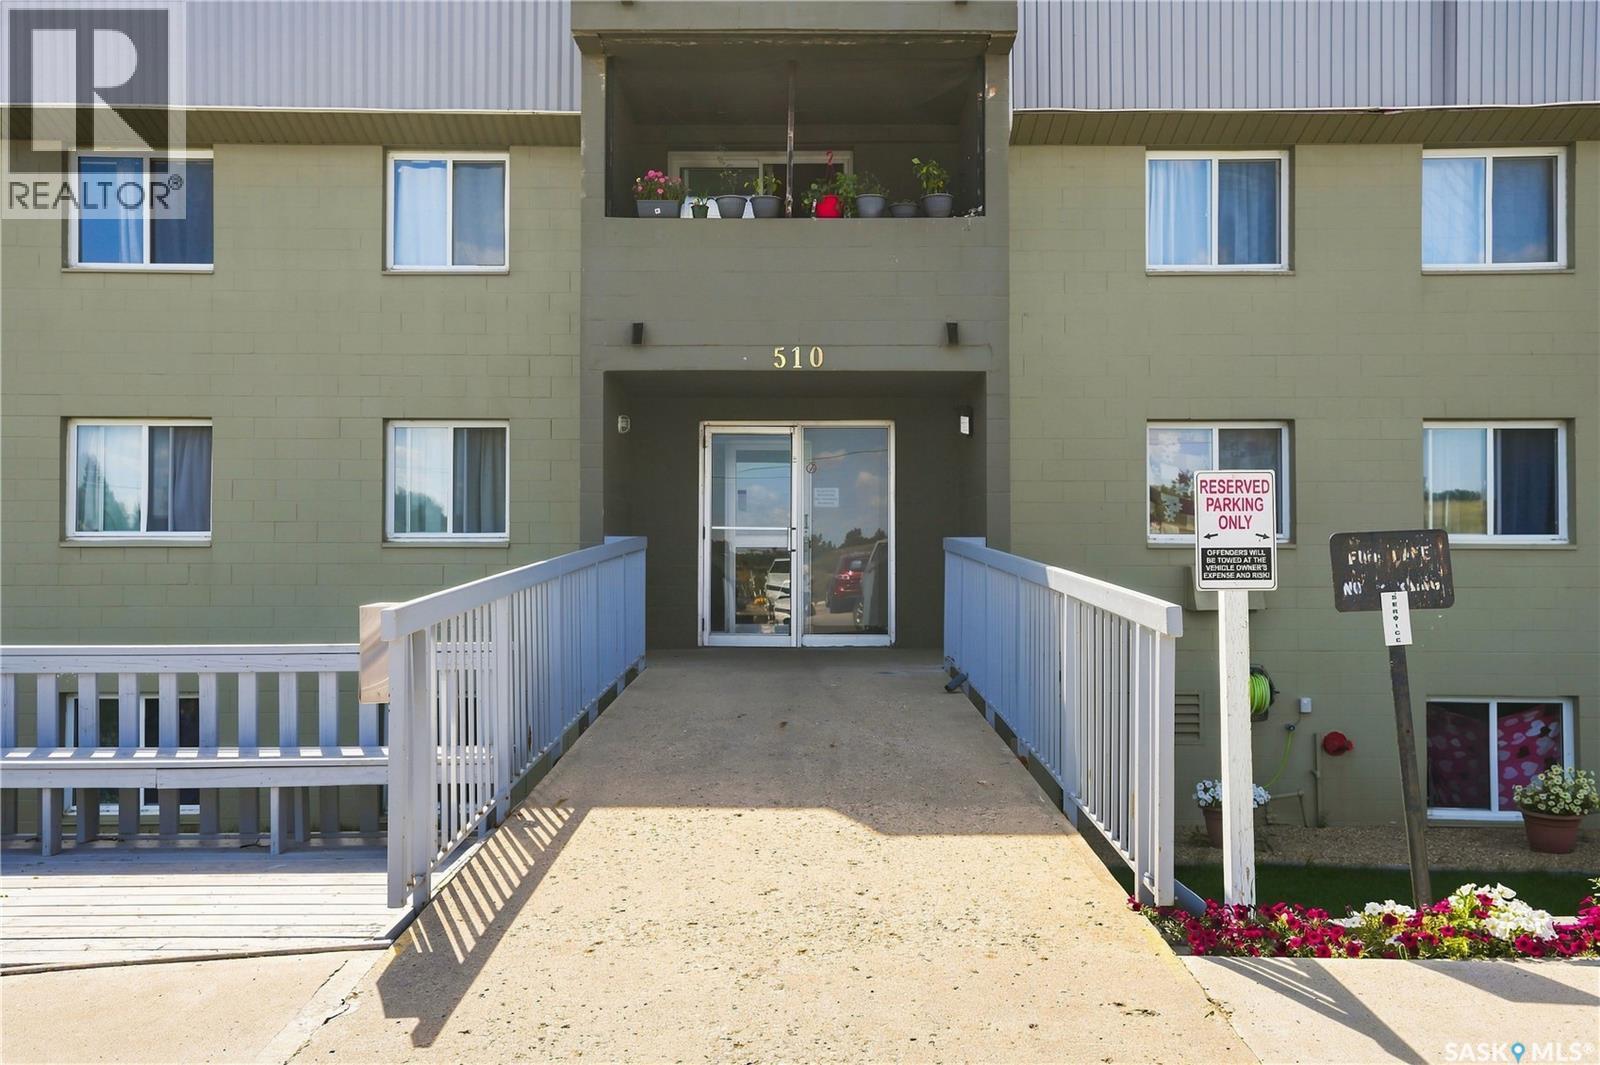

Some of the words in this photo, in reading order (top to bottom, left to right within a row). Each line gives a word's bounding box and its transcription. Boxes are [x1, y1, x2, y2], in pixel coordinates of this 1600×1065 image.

[773, 345, 824, 369] 510
[1199, 479, 1270, 494] RESERVED
[1206, 497, 1264, 512] PARKING
[1218, 515, 1253, 530] ONLY
[1343, 581, 1362, 596] NO
